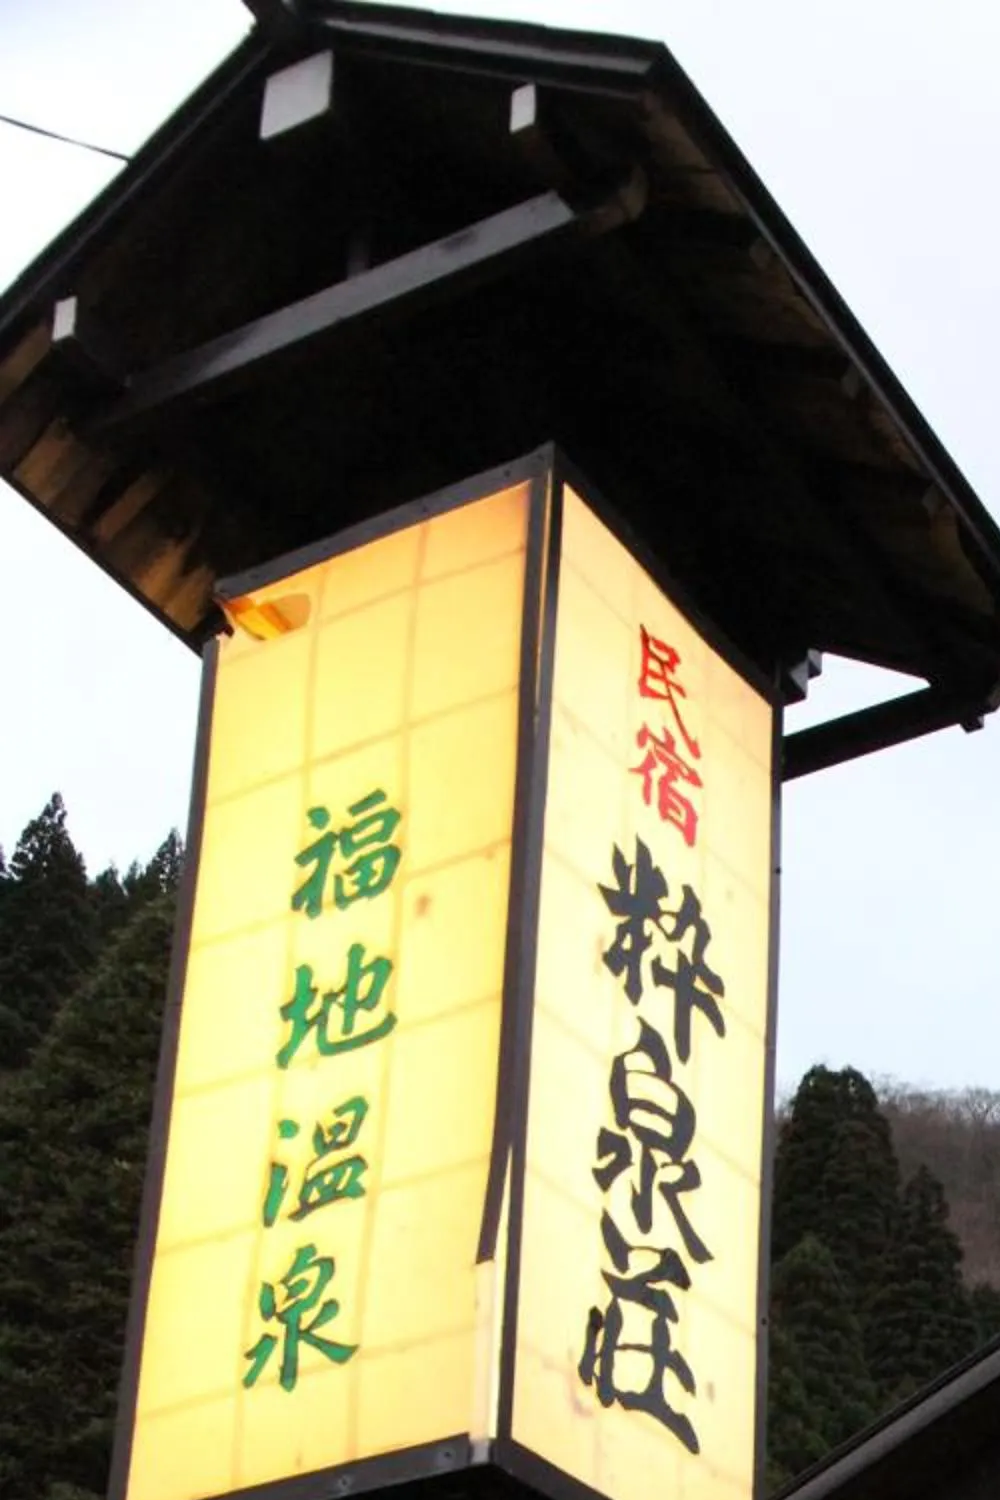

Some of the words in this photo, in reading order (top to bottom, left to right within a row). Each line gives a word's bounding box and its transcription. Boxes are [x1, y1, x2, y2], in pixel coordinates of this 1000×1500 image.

[631, 624, 703, 846] 民宿
[242, 789, 402, 1392] 福地温泉
[579, 836, 726, 1455] 粋泉荘
